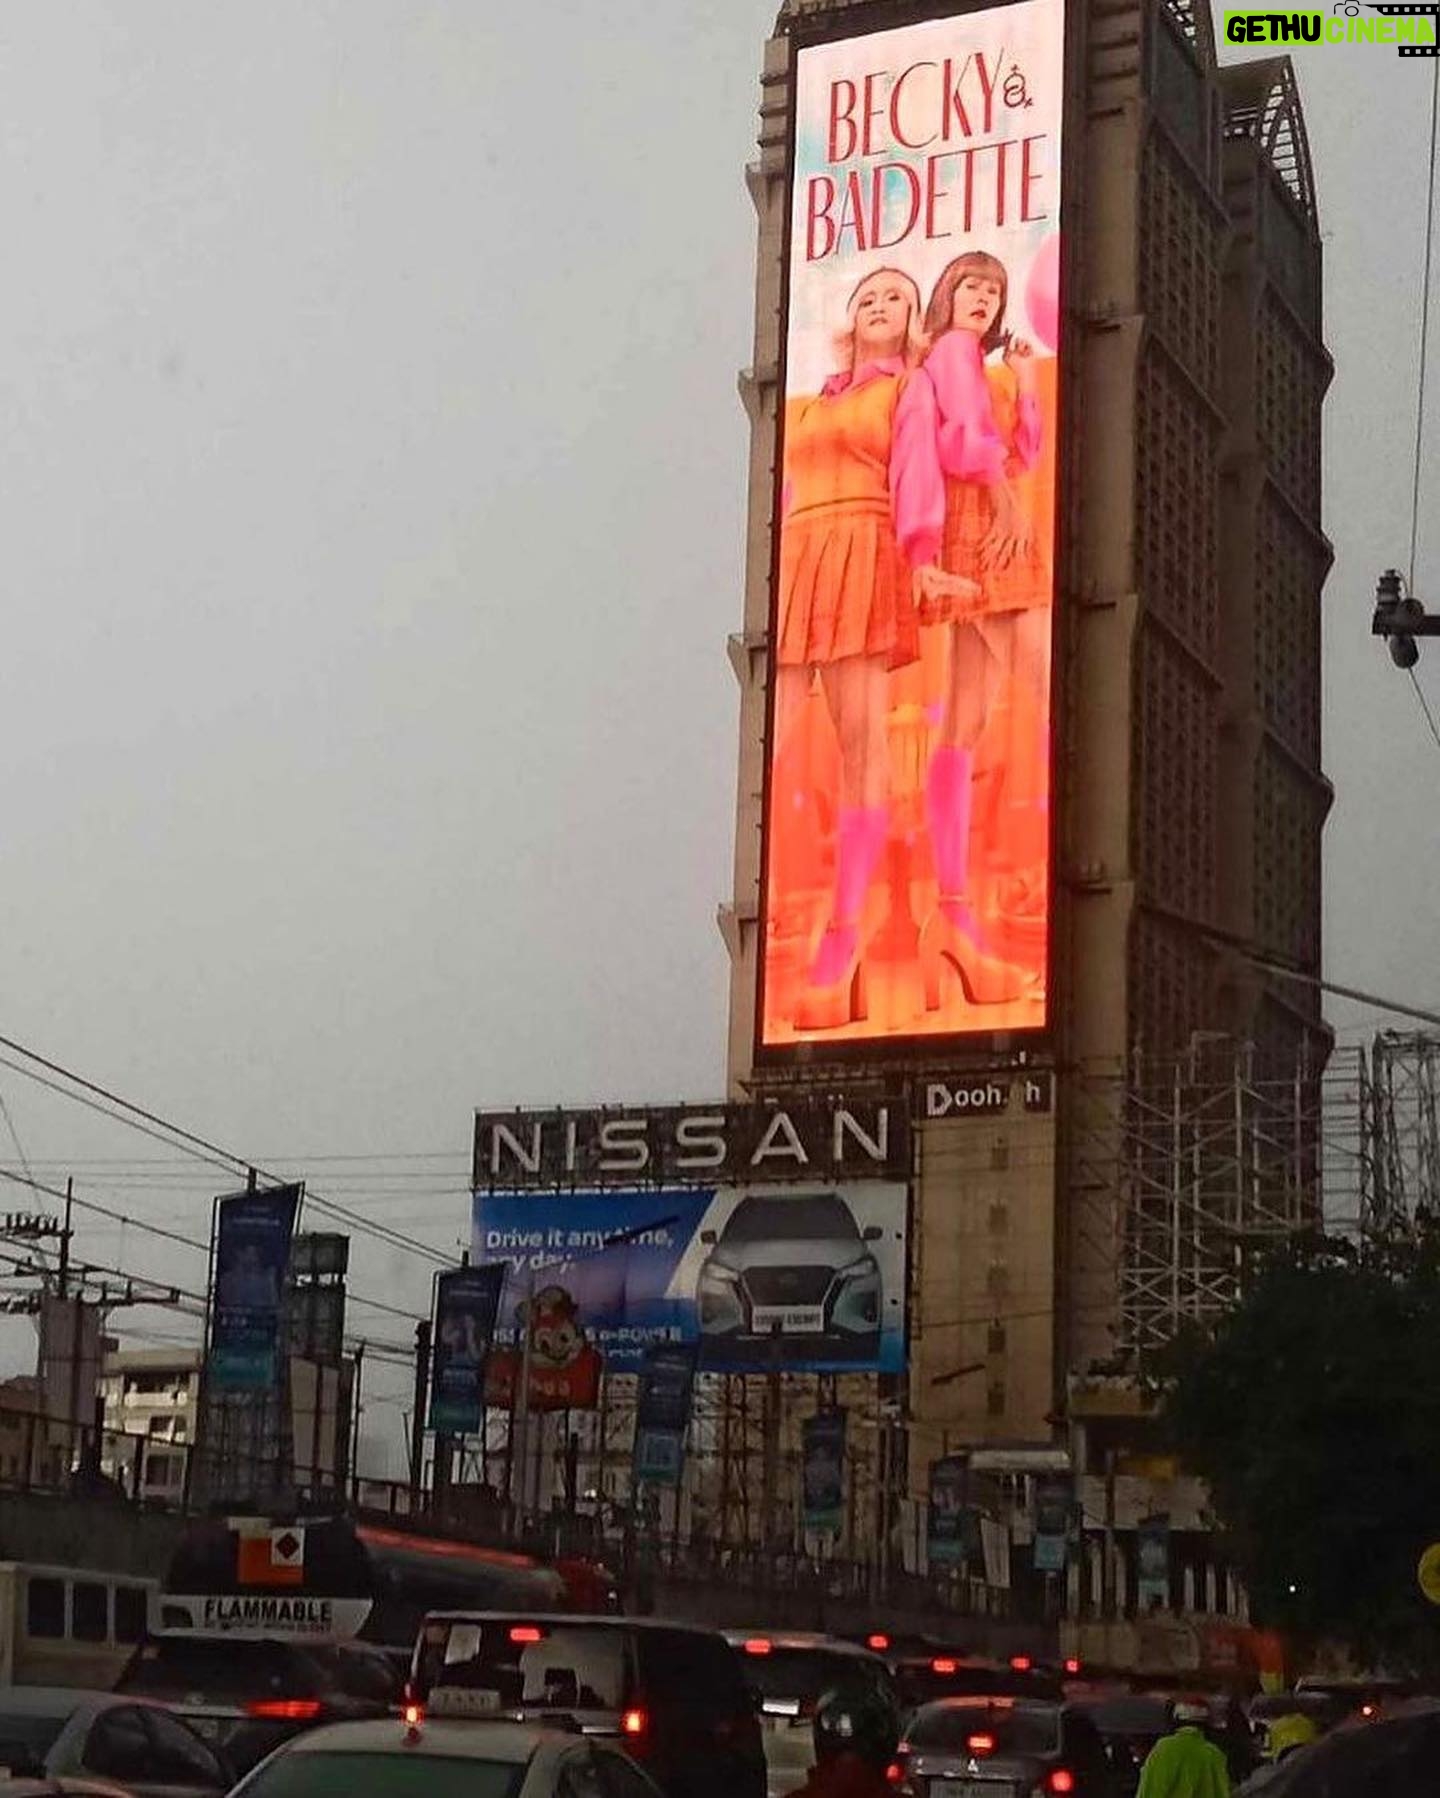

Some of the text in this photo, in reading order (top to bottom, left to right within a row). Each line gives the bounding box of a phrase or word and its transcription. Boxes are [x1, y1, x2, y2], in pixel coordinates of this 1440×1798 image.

[828, 47, 1005, 164] BECKY
[806, 134, 1048, 262] BADETTE
[490, 1108, 889, 1174] NISSAN
[486, 1228, 541, 1248] Drive
[548, 1227, 565, 1247] it
[205, 1598, 333, 1622] FLAMMABLE
